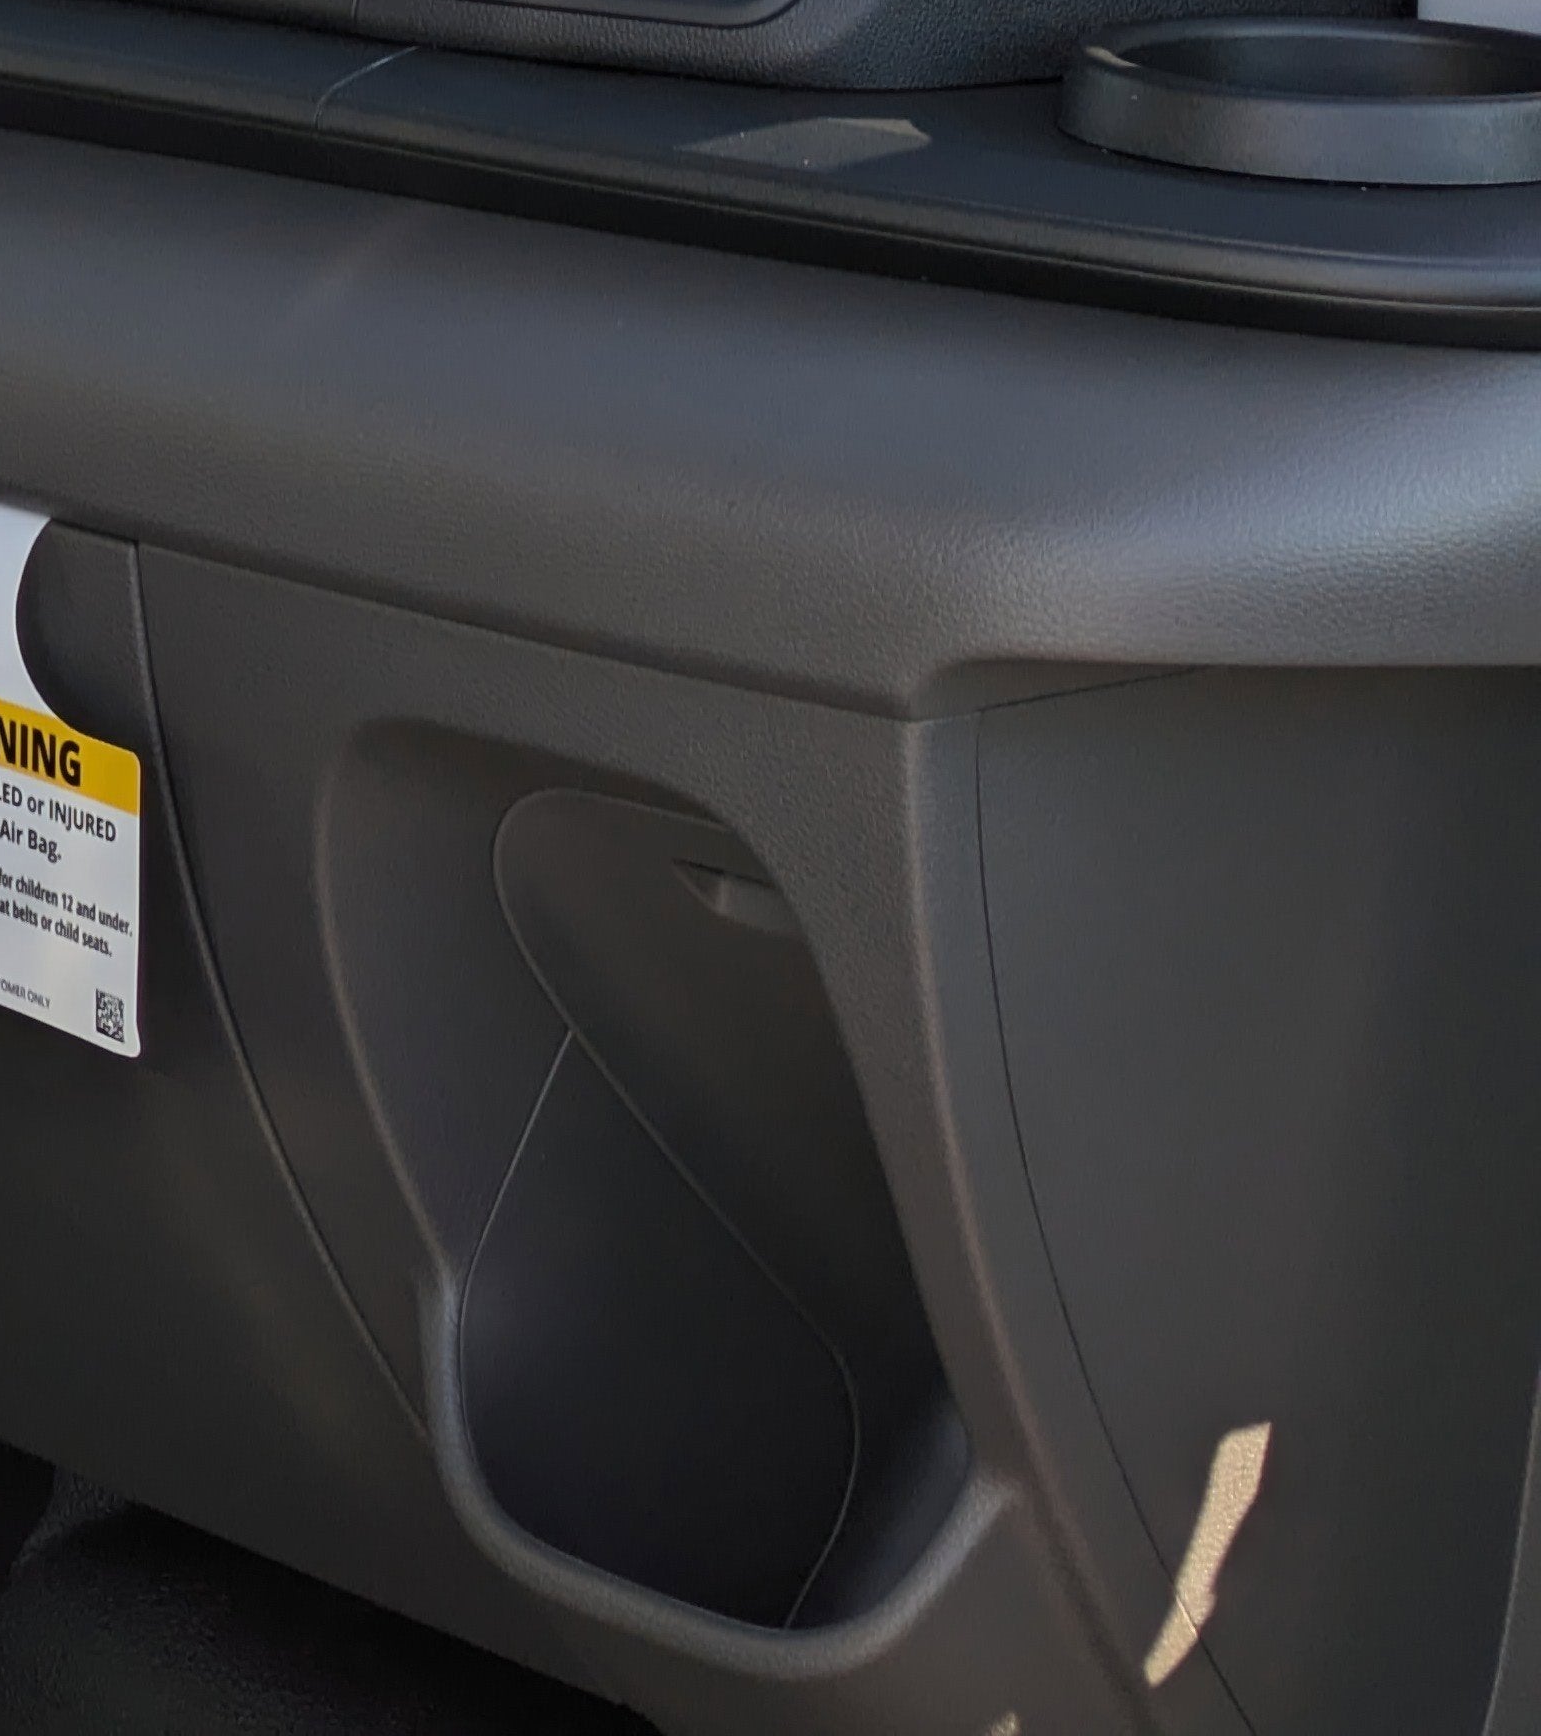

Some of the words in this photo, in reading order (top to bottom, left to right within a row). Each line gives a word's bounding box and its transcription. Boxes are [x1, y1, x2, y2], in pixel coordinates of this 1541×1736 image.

[0, 818, 23, 845] Air
[27, 829, 62, 864] Bag.
[27, 796, 44, 815] or
[49, 798, 117, 842] INJURED
[12, 899, 38, 927] belts
[40, 914, 53, 932] or
[55, 918, 80, 944] child
[82, 931, 113, 958] seats.
[15, 876, 59, 907] children
[61, 892, 74, 913] 12
[76, 900, 96, 922] and
[98, 909, 133, 937] under.
[27, 989, 51, 1010] ONLY
